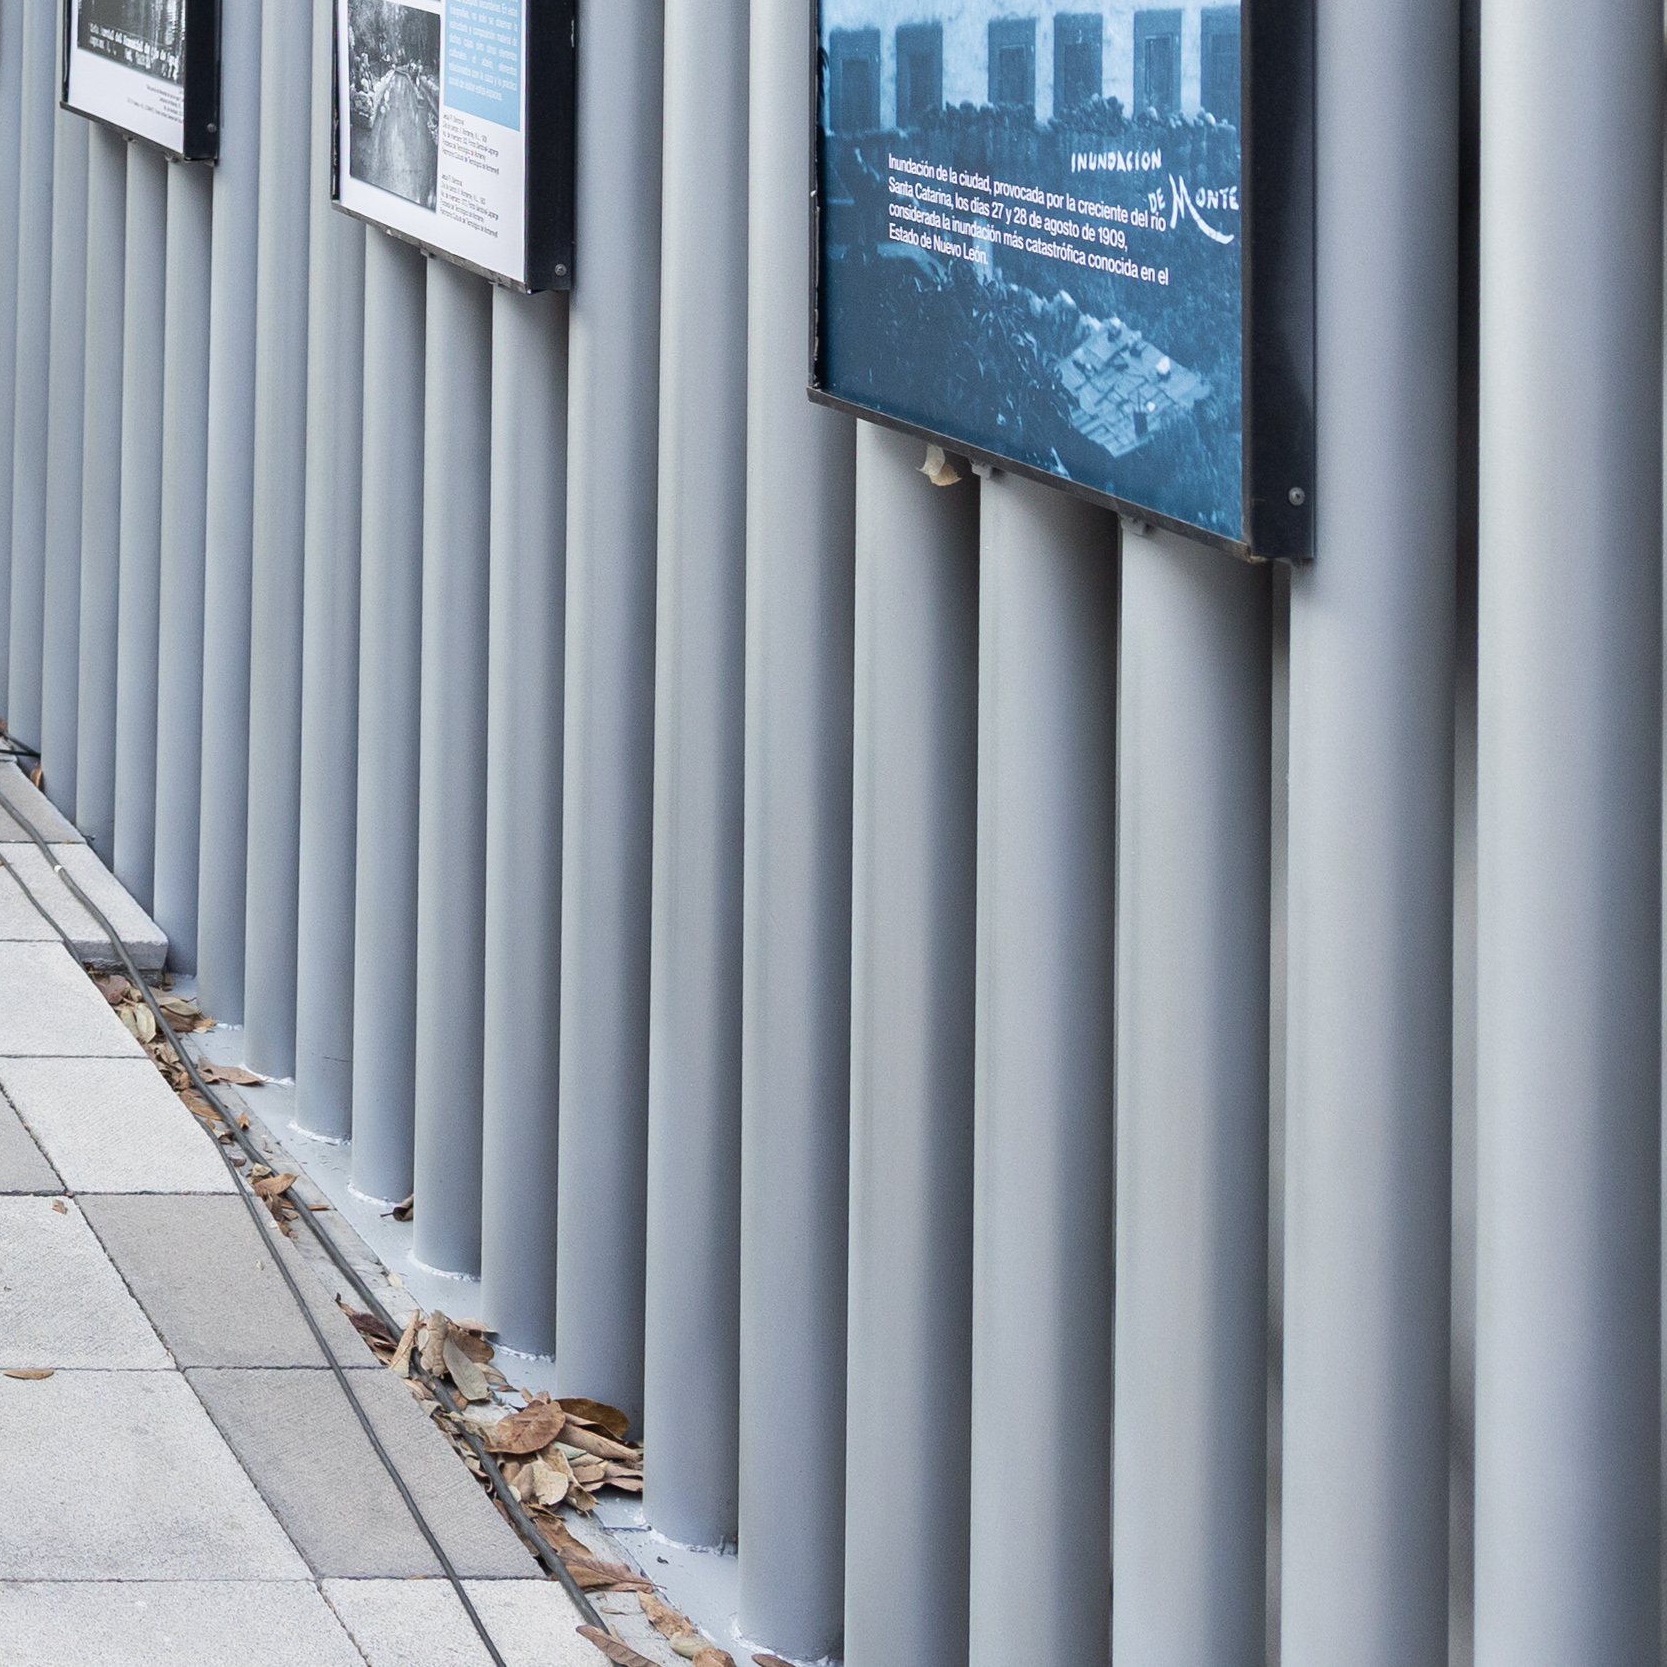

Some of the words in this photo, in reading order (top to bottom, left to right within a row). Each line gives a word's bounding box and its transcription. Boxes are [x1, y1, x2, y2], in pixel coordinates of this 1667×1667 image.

[1070, 147, 1162, 173] INUNDACION
[888, 152, 935, 179] Inundación
[935, 164, 948, 182] de
[949, 166, 958, 184] la
[958, 170, 992, 195] ciudad,
[993, 180, 1045, 206] provocada
[1046, 192, 1064, 210] por
[1066, 192, 1076, 212] la
[1077, 200, 1129, 224] creciente
[1130, 207, 1148, 228] del
[1151, 211, 1167, 232] río
[888, 176, 913, 197] Santa
[914, 182, 954, 210] Catarina,
[955, 192, 969, 212] los
[970, 197, 990, 217] días
[991, 201, 1005, 219] 27
[1005, 207, 1012, 225] y
[1013, 206, 1027, 226] 28
[1029, 211, 1042, 229] de
[1043, 217, 1079, 238] agosto
[1081, 222, 1096, 242] de
[1097, 226, 1128, 252] 1909,
[1147, 187, 1166, 213] DE
[888, 222, 919, 246] Estado
[920, 232, 932, 249] de
[933, 234, 962, 258] Nuevo
[963, 242, 989, 265] León.
[888, 203, 941, 229] considerada
[942, 213, 951, 231] la
[951, 215, 1002, 244] inundación
[1003, 230, 1024, 250] más
[1025, 237, 1086, 266] catastrófica
[1087, 253, 1139, 279] conocida
[1140, 265, 1156, 283] en
[1157, 266, 1169, 286] el
